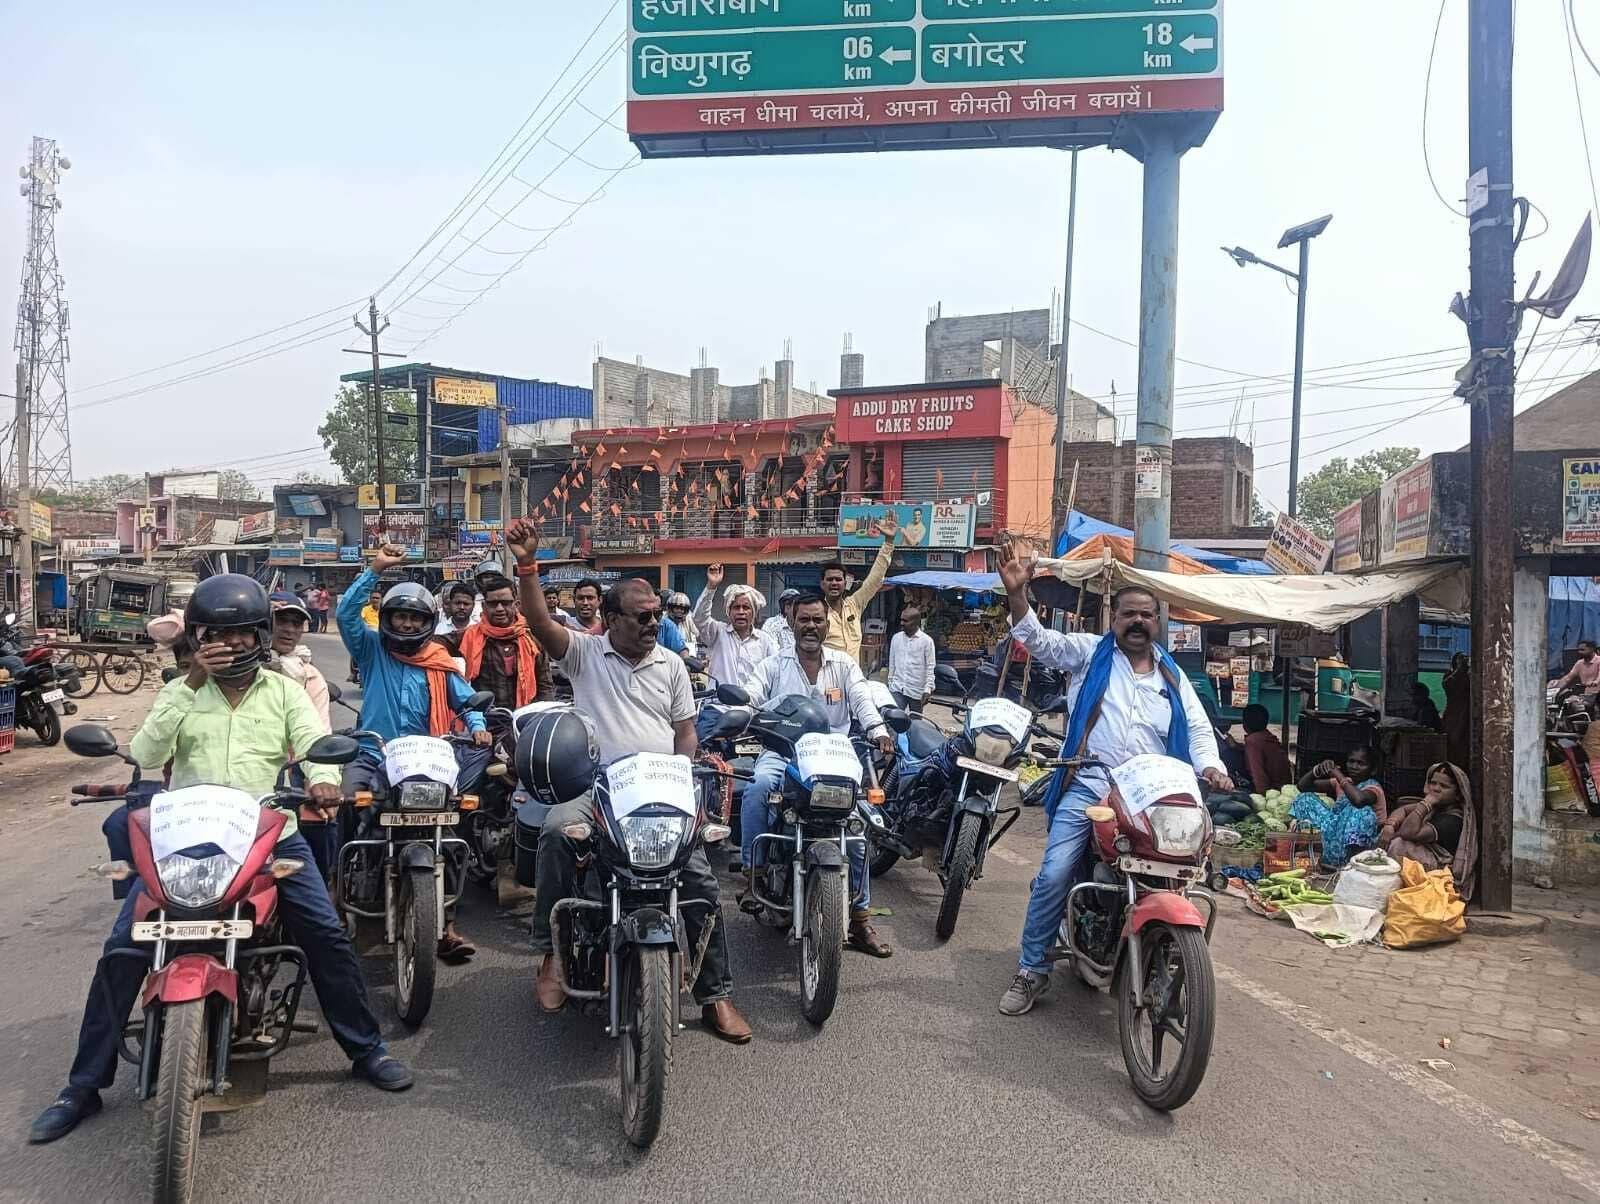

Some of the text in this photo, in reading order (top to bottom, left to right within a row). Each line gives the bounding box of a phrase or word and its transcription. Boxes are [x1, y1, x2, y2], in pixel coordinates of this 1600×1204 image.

[1142, 23, 1173, 46] 18
[843, 36, 873, 59] 06
[929, 33, 1027, 68] बगोदर
[638, 44, 752, 87] विष्णुगढ़
[1143, 51, 1172, 68] km
[844, 64, 872, 81] km
[699, 106, 746, 126] वाहन
[755, 100, 798, 124] धीमा
[885, 98, 938, 118] अपना
[950, 91, 1012, 115] कीमती
[1021, 88, 1077, 112] जीवन
[852, 395, 974, 417] ADDU DRY FRUITS
[875, 415, 954, 433] CAKE SHOP
